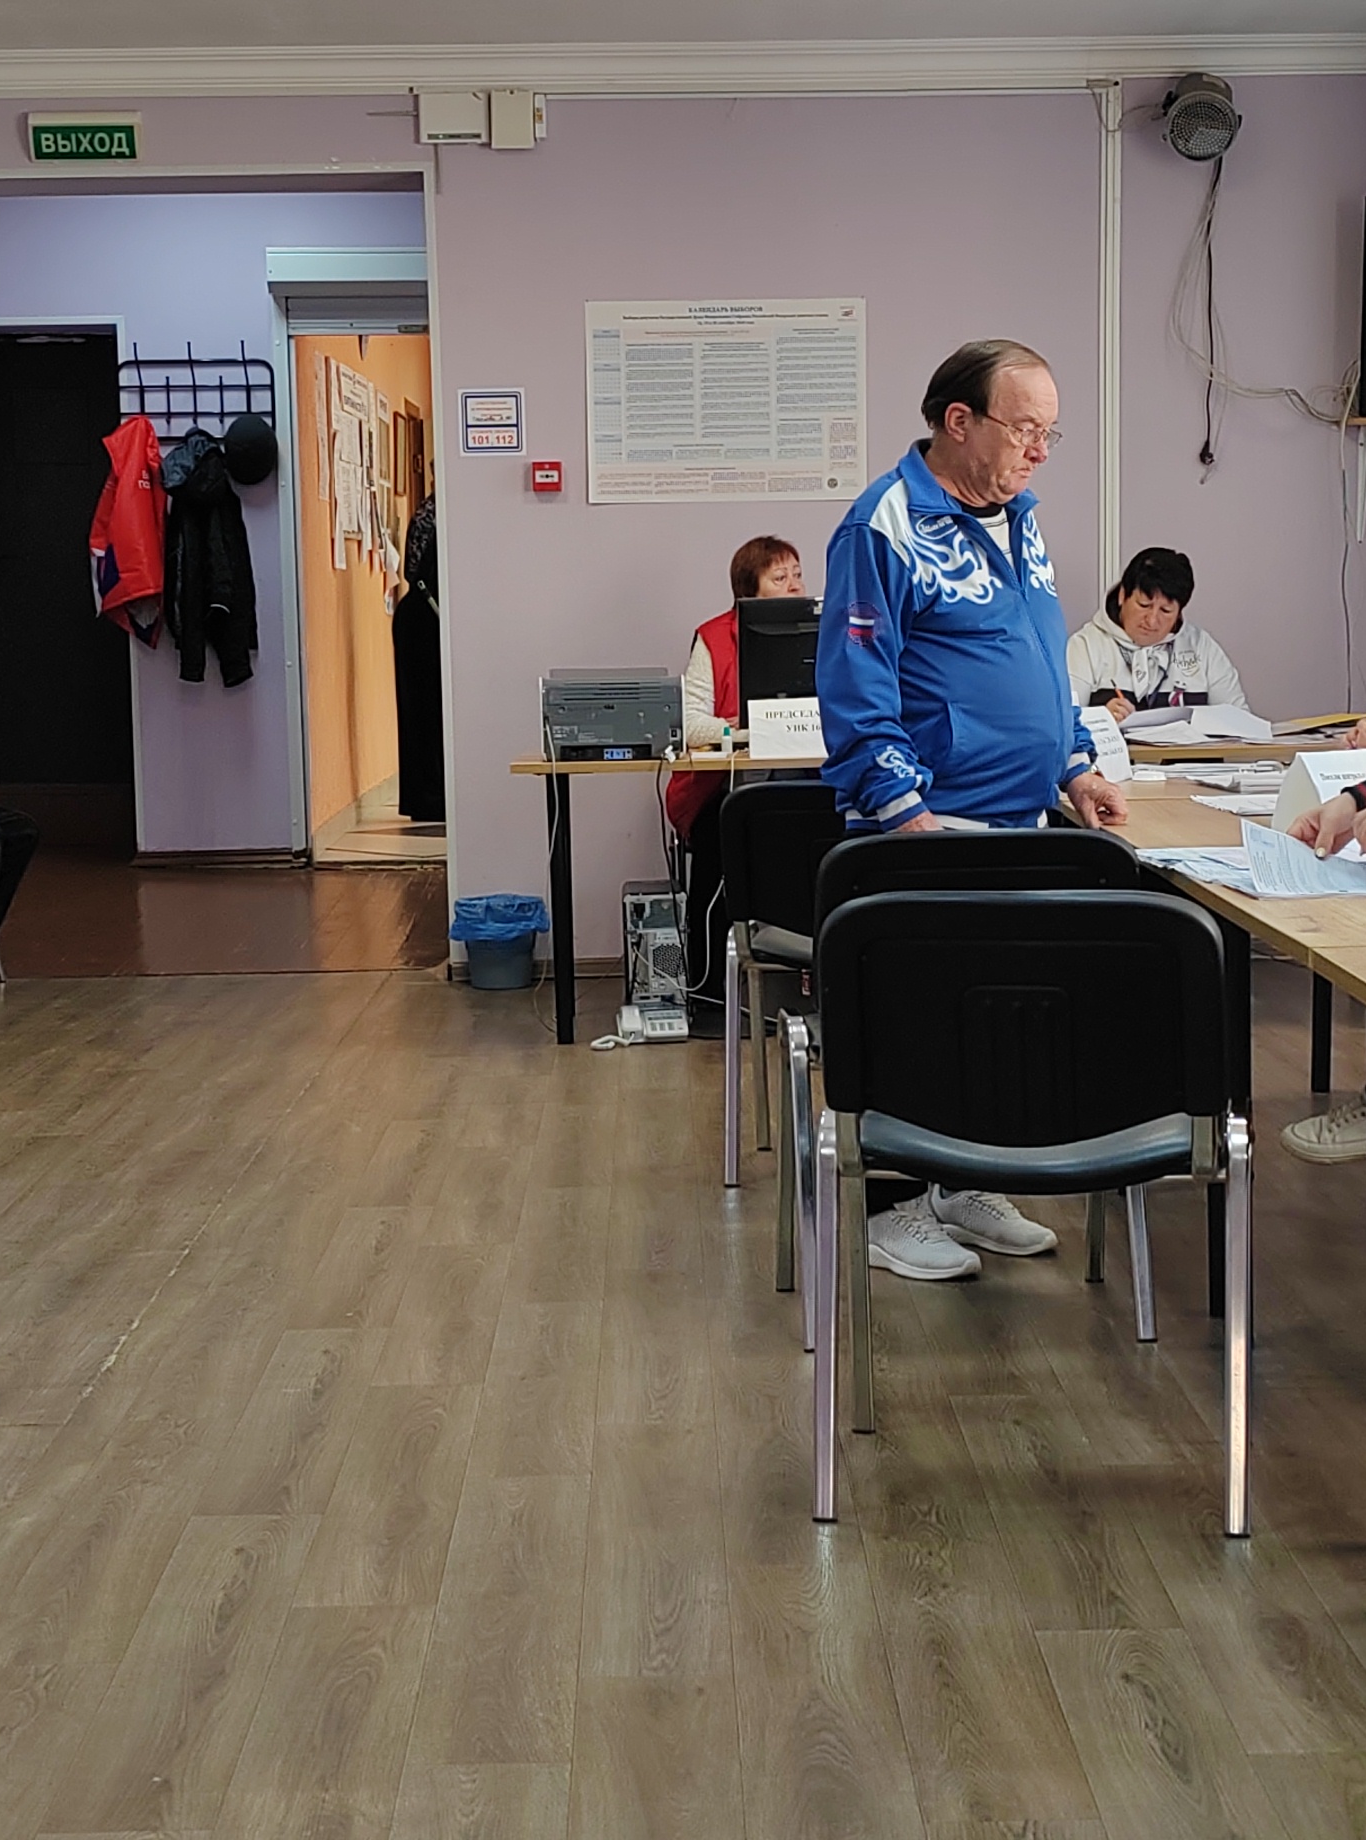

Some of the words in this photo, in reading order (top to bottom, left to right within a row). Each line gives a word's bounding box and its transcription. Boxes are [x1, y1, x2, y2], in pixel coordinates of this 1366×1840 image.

[40, 132, 130, 156] ВЫХОД
[495, 434, 514, 445] 112
[786, 724, 809, 733] УИК
